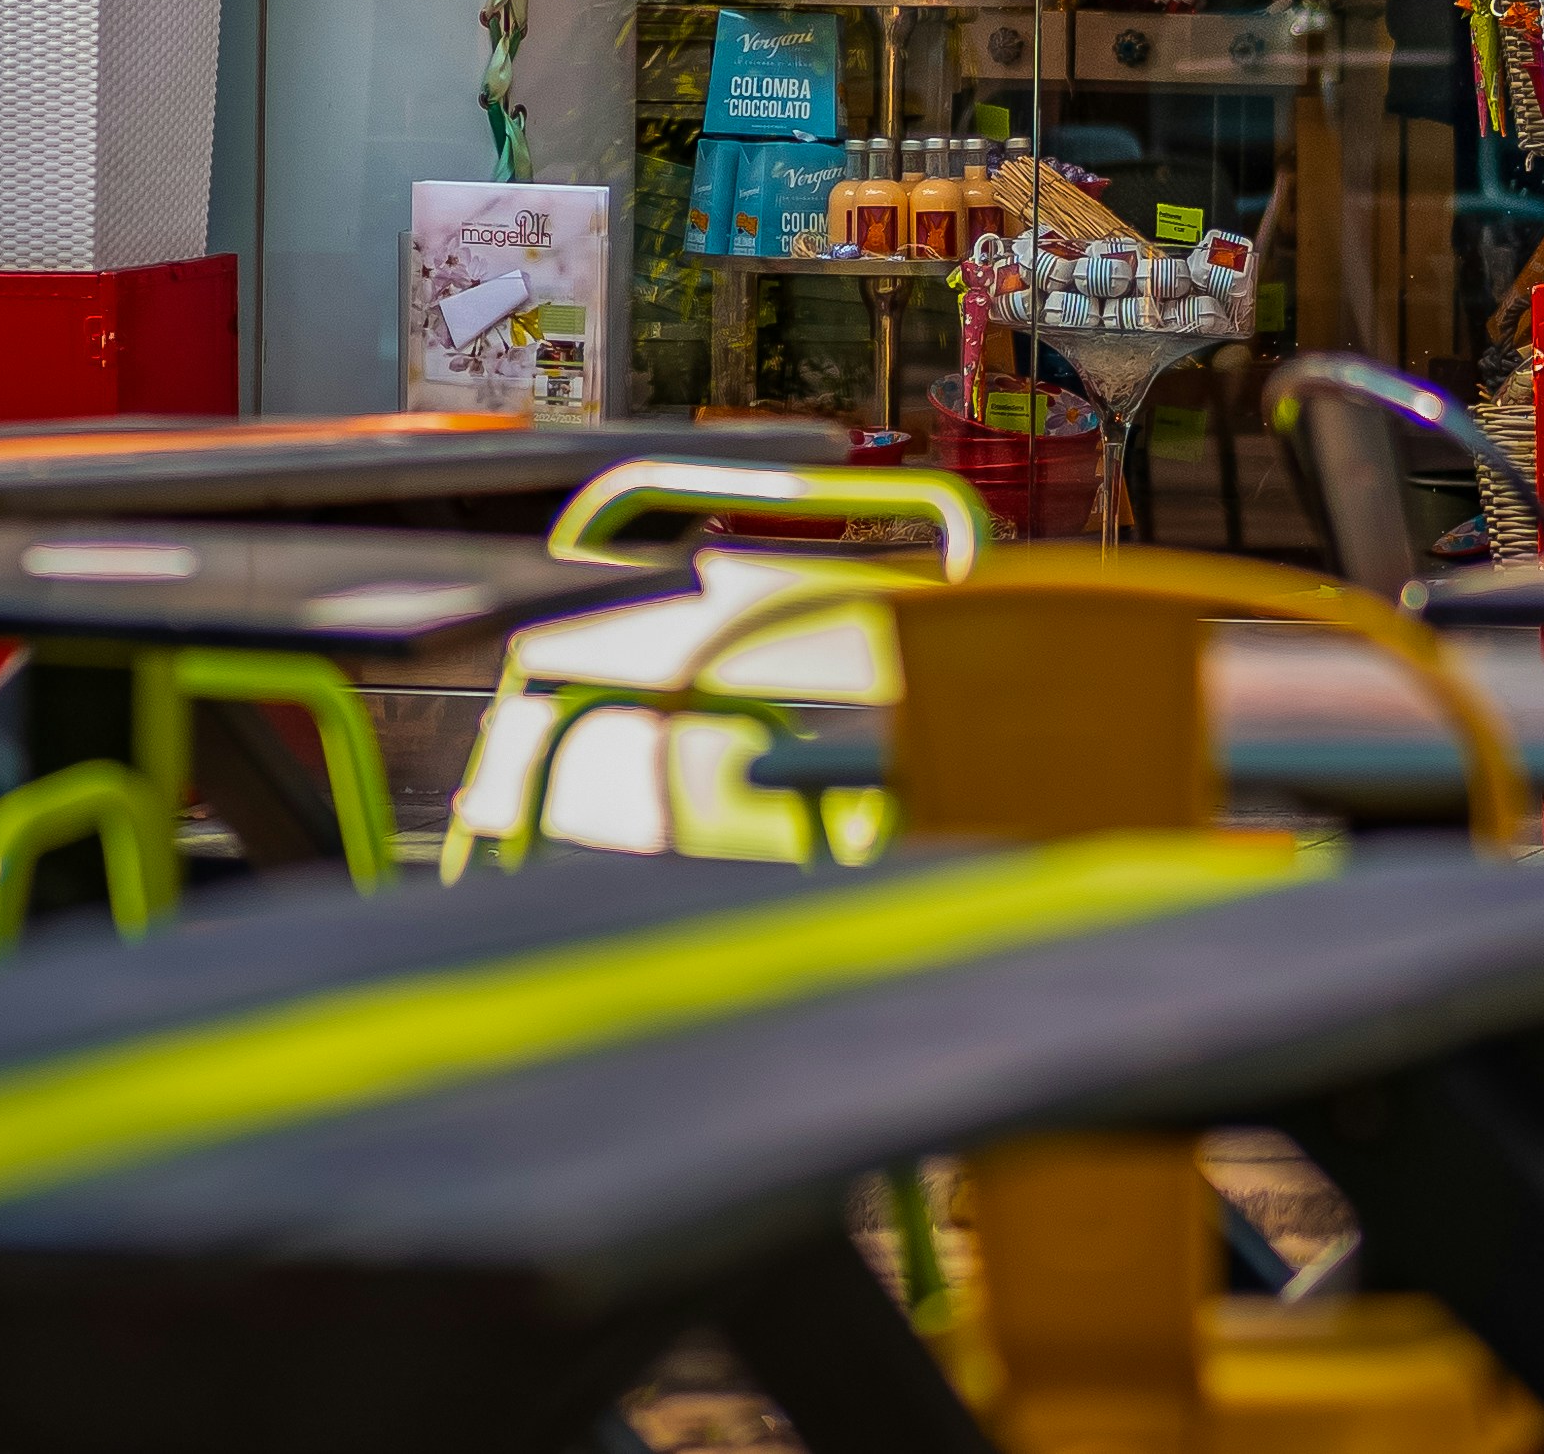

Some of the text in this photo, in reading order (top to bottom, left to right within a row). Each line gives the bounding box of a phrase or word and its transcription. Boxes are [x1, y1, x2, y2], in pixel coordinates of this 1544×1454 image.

[736, 28, 815, 59] Vergani
[730, 76, 811, 99] COLOMBA
[729, 98, 811, 120] CIOCCOLATO
[781, 212, 829, 233] COLOM
